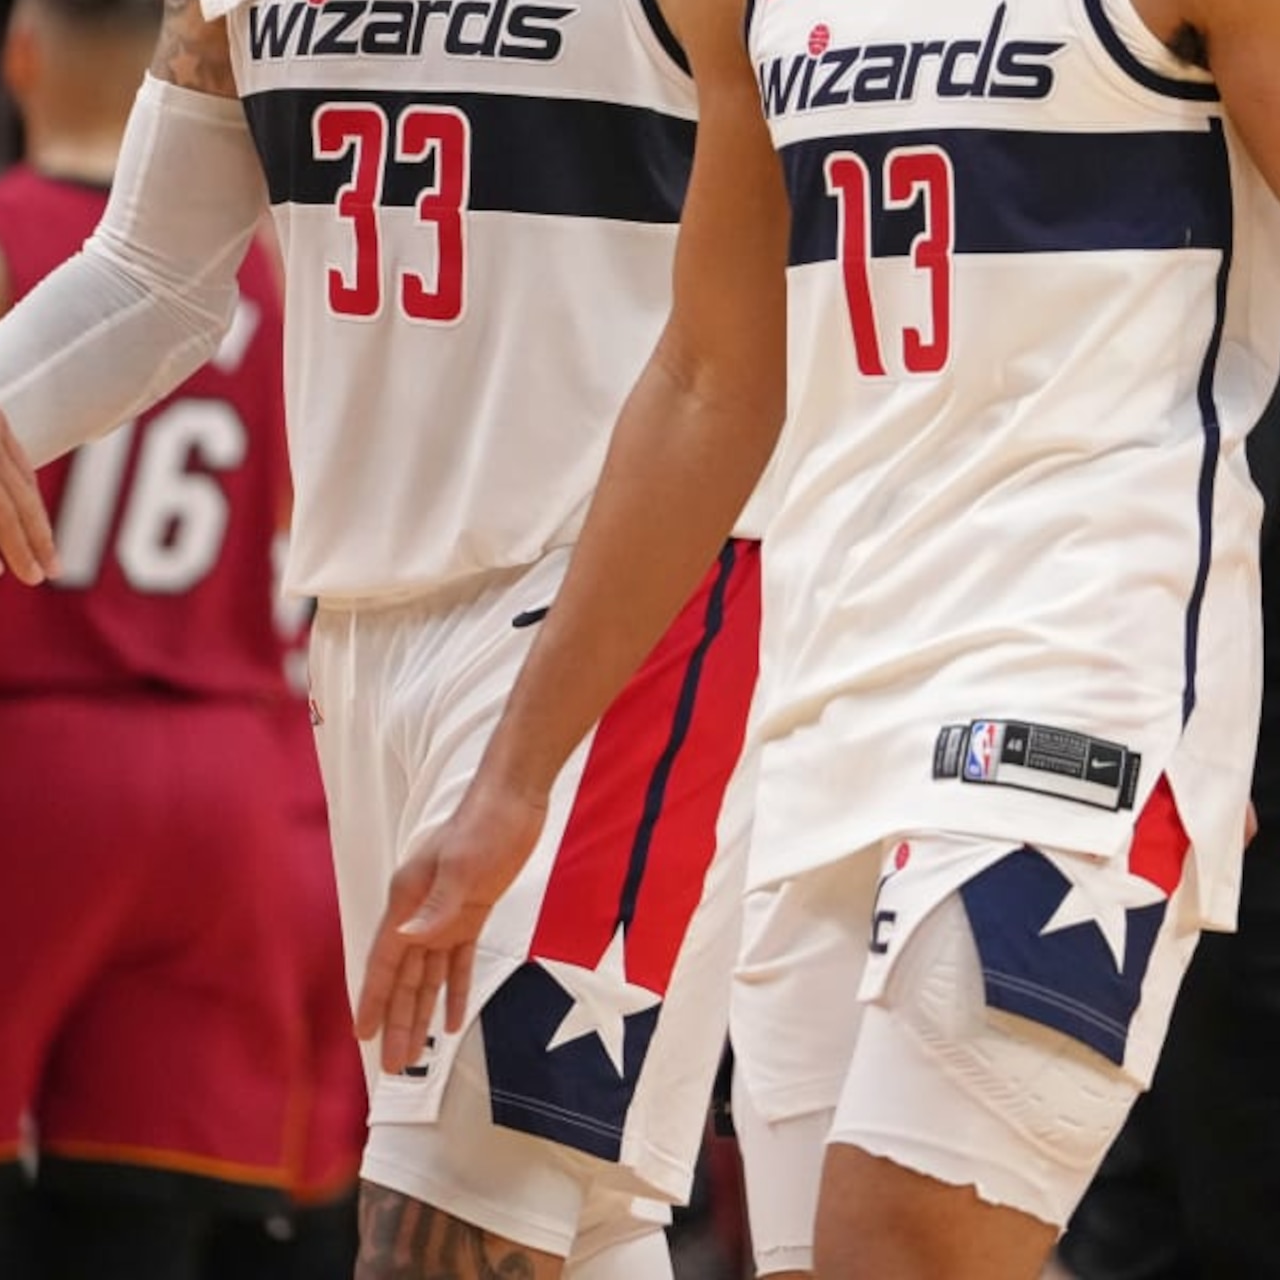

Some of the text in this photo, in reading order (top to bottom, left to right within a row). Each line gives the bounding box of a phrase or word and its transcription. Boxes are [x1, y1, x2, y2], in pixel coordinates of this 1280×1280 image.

[313, 102, 470, 326] 33
[824, 145, 955, 381] 13
[55, 396, 248, 596] 16
